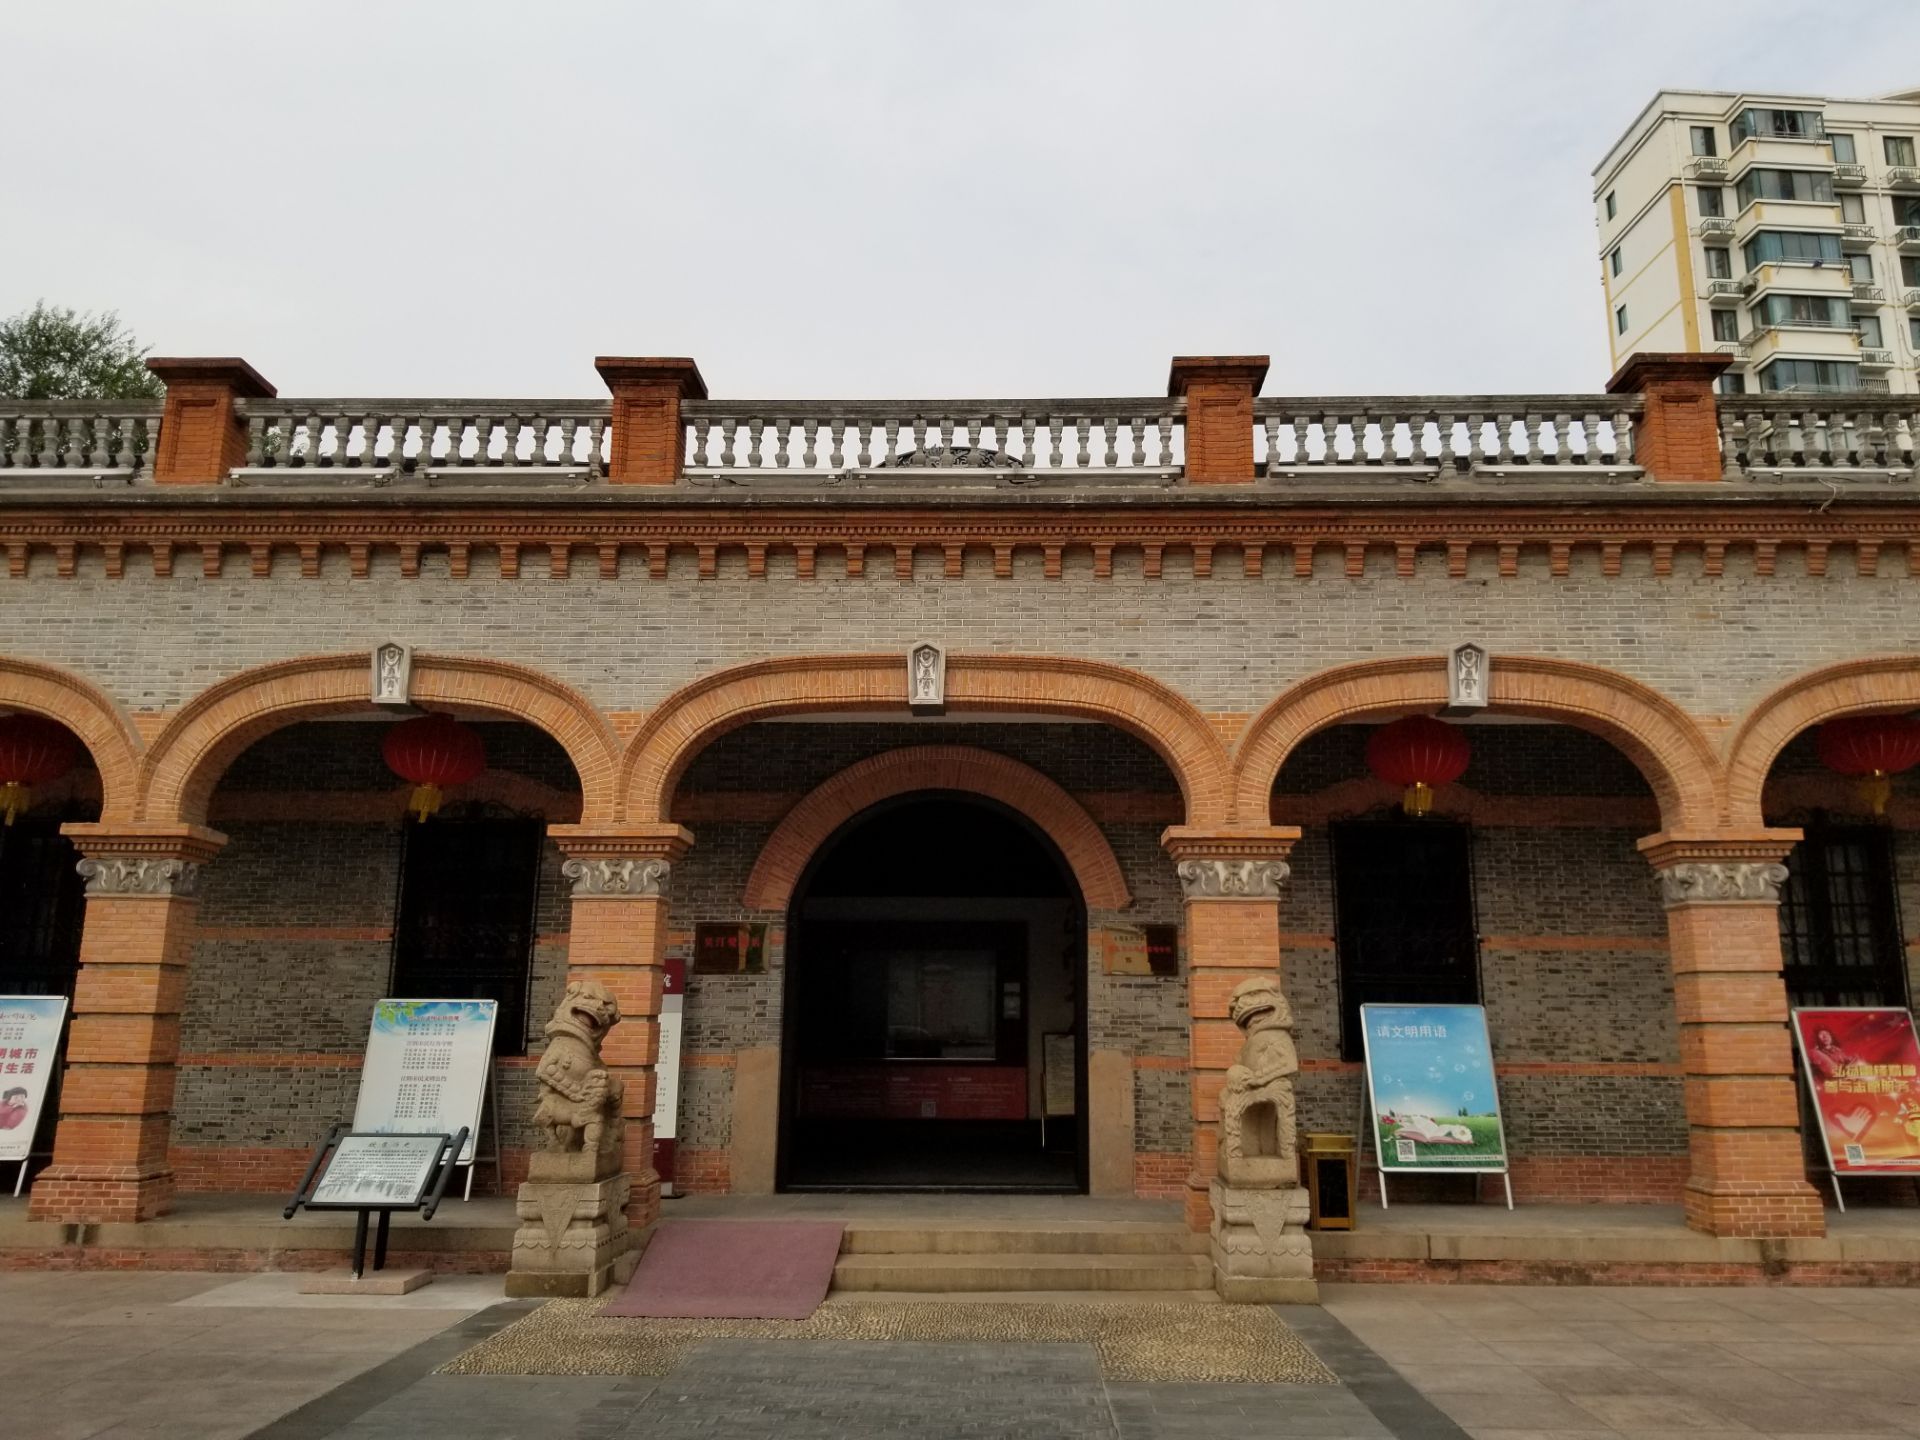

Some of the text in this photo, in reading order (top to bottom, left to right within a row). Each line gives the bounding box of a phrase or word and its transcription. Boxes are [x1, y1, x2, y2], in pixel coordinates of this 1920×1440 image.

[1375, 1024, 1448, 1039] 请文明用语
[0, 1062, 35, 1074] 生活
[1823, 1079, 1911, 1094] 参与志愿服务
